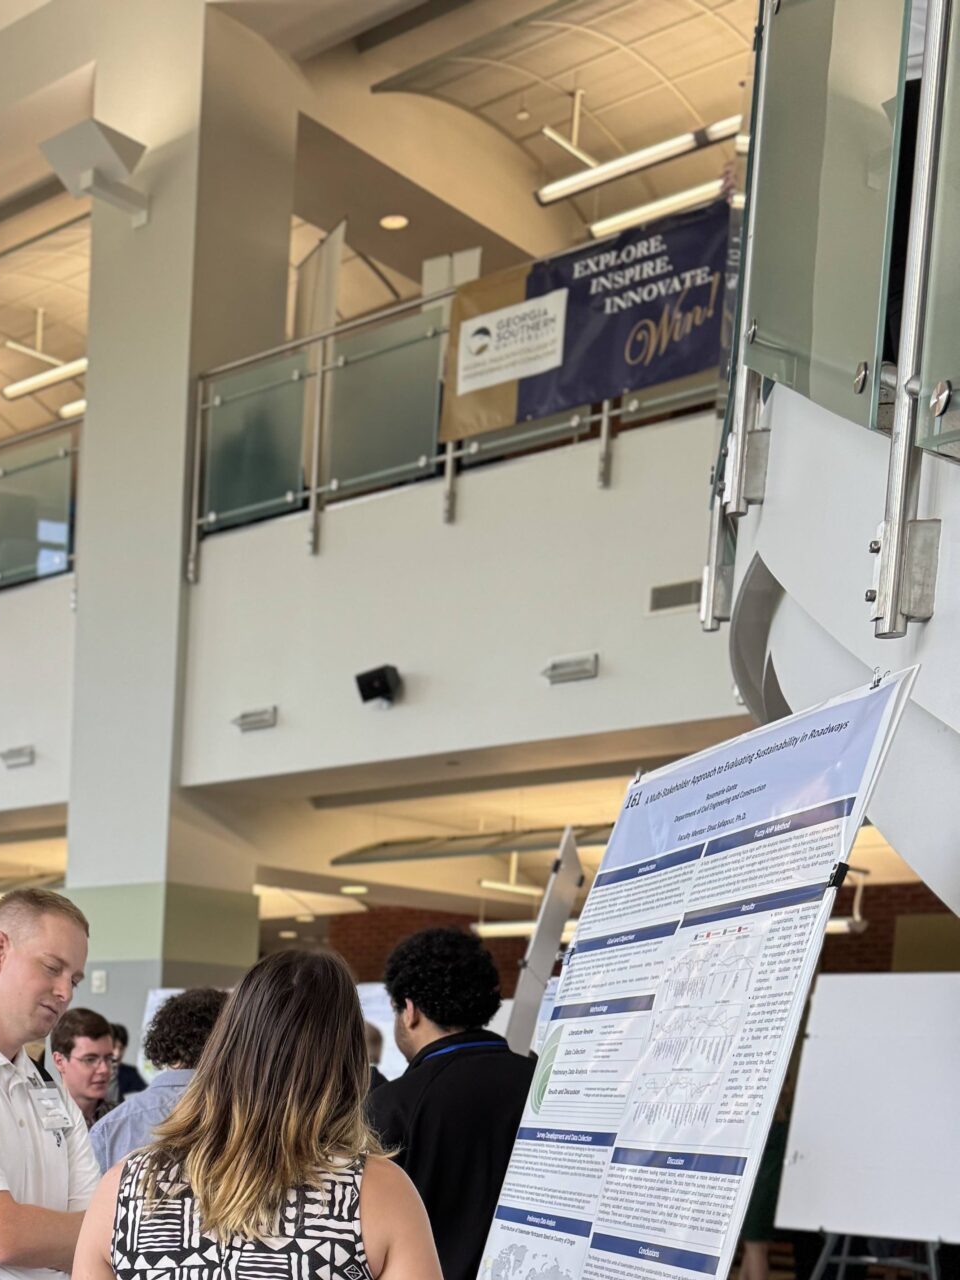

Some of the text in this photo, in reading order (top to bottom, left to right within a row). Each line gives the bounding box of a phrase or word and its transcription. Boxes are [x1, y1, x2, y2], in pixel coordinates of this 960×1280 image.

[572, 234, 667, 280] EXPLORE.
[589, 256, 673, 295] INSPIRE.
[604, 266, 714, 314] INNOVATE.
[496, 308, 548, 330] GEORGIA
[496, 314, 557, 342] SOUTHERN
[624, 271, 720, 367] Win!
[625, 791, 643, 809] 161
[649, 779, 692, 802] Multi-Stakeholder
[690, 766, 717, 785] Approach
[716, 764, 724, 774] to
[723, 753, 755, 773] Evaluating
[754, 736, 800, 760] Sustainability
[800, 732, 808, 742] in
[808, 720, 850, 740] Roadways
[674, 810, 696, 823] Department
[700, 804, 709, 813] Civil
[709, 797, 731, 811] Engineering
[731, 792, 740, 801] and
[739, 784, 767, 799] Construction
[753, 819, 791, 839] Fuzzy AHP Method
[740, 902, 756, 912] Results
[536, 1131, 545, 1139] Survey
[546, 1131, 565, 1140] Development
[578, 1134, 592, 1142] Collection
[666, 1156, 685, 1166] Discussion
[638, 1246, 660, 1258] Conclusions
